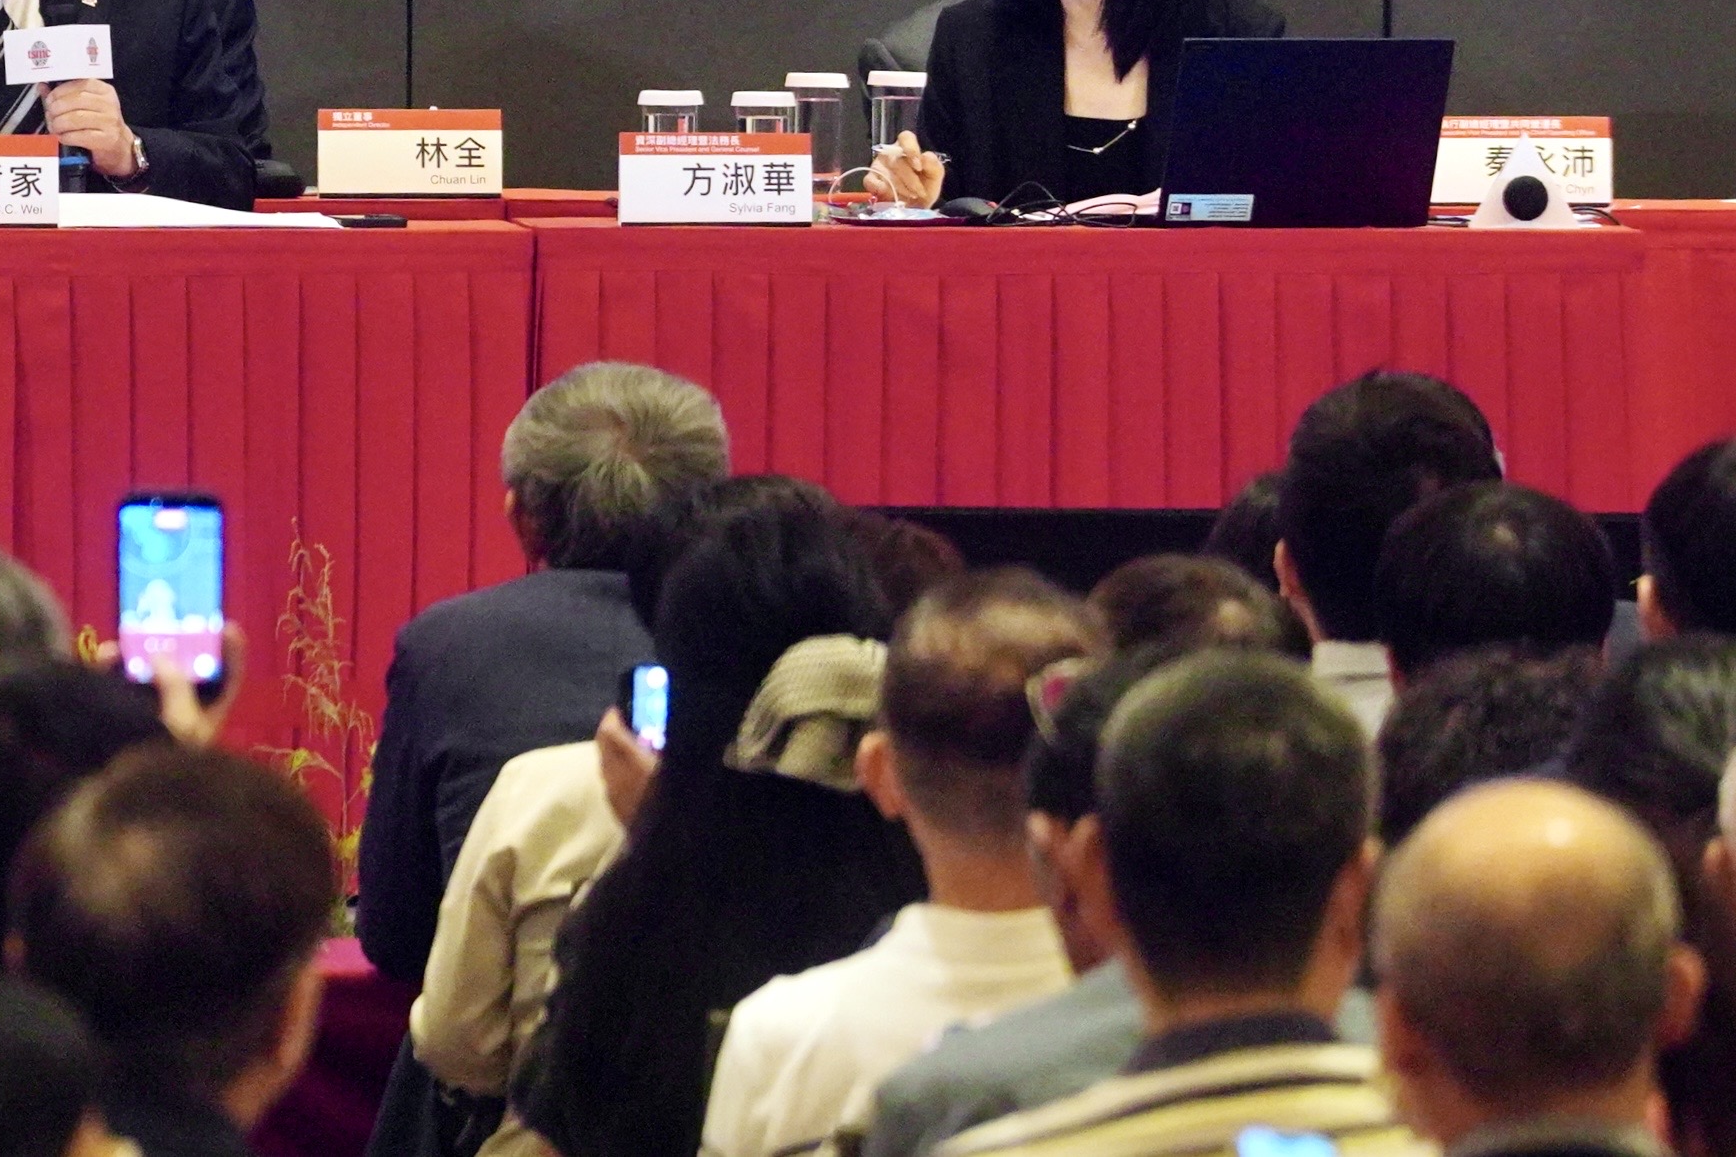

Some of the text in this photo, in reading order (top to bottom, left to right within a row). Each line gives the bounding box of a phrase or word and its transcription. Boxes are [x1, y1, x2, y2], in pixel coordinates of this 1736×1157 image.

[416, 137, 486, 168] 林全
[430, 175, 486, 184] Chuan Lin
[682, 163, 795, 196] 方淑華
[1566, 184, 1594, 196] Chyn
[21, 204, 42, 214] Wei
[729, 202, 796, 215] Sylvia Fang
